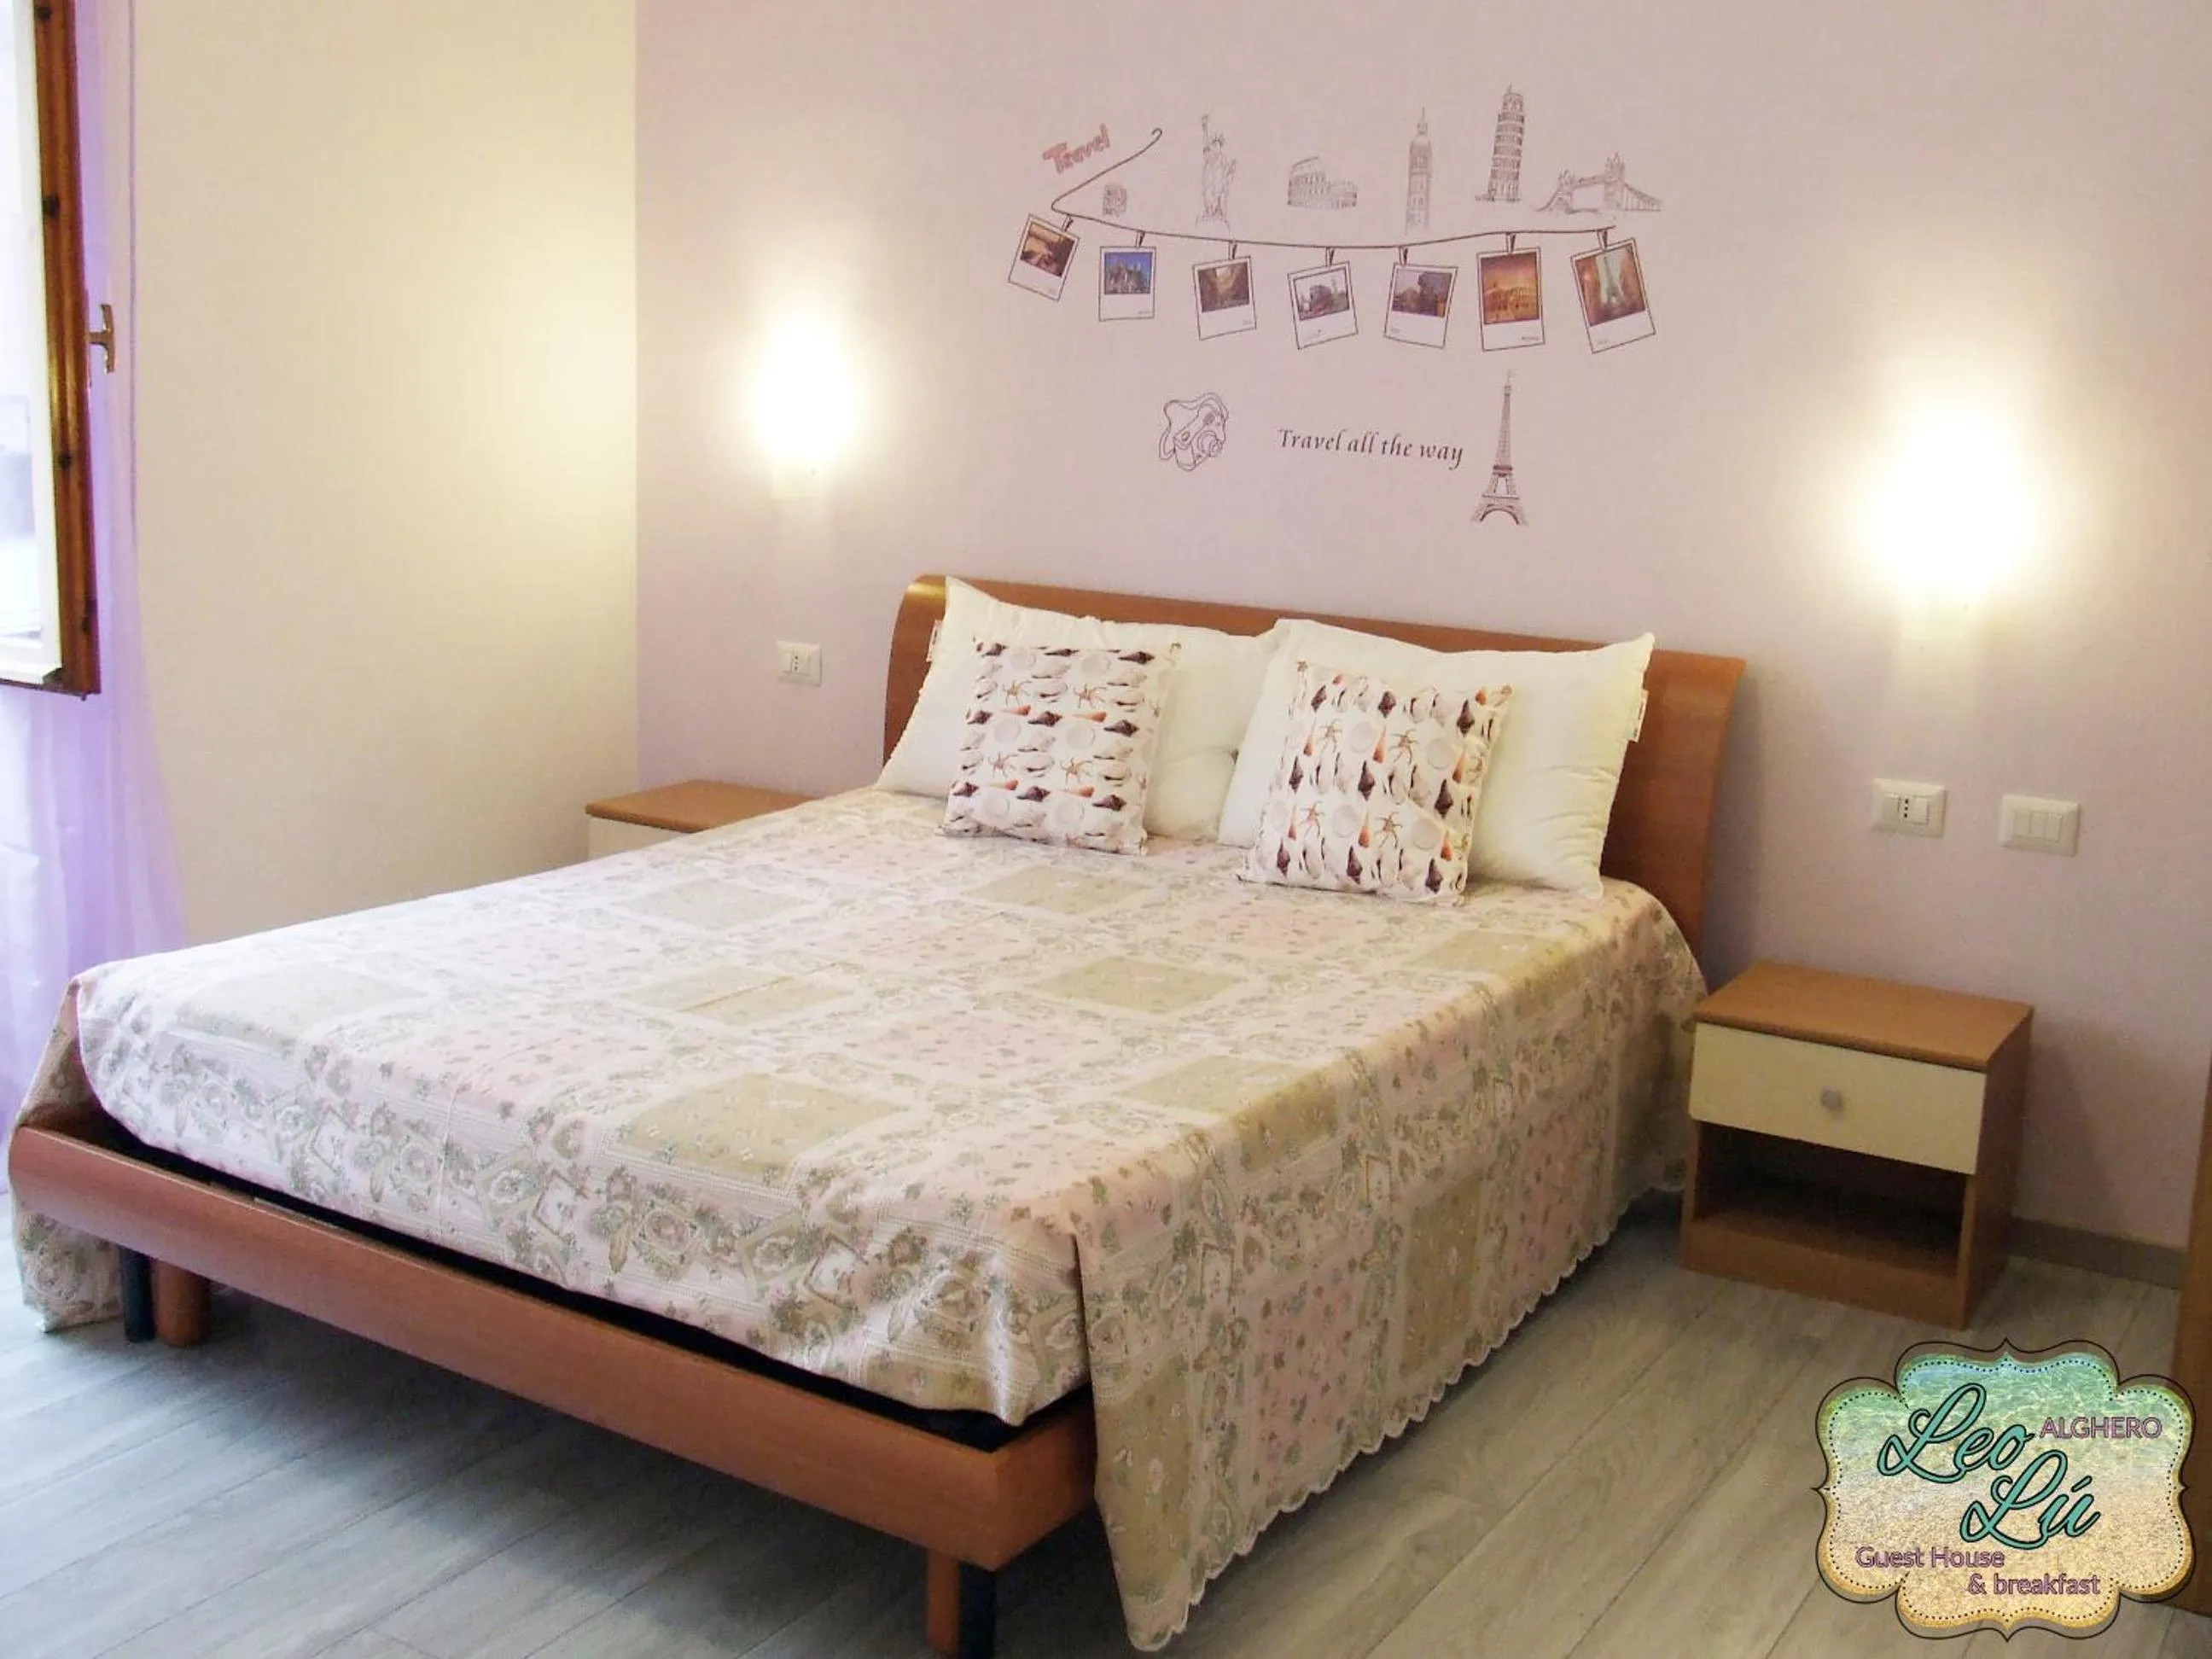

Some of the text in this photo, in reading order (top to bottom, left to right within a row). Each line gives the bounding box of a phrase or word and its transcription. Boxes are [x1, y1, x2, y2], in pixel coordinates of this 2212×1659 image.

[1042, 124, 1110, 174] Travel
[1278, 428, 1464, 470] Travel all the way
